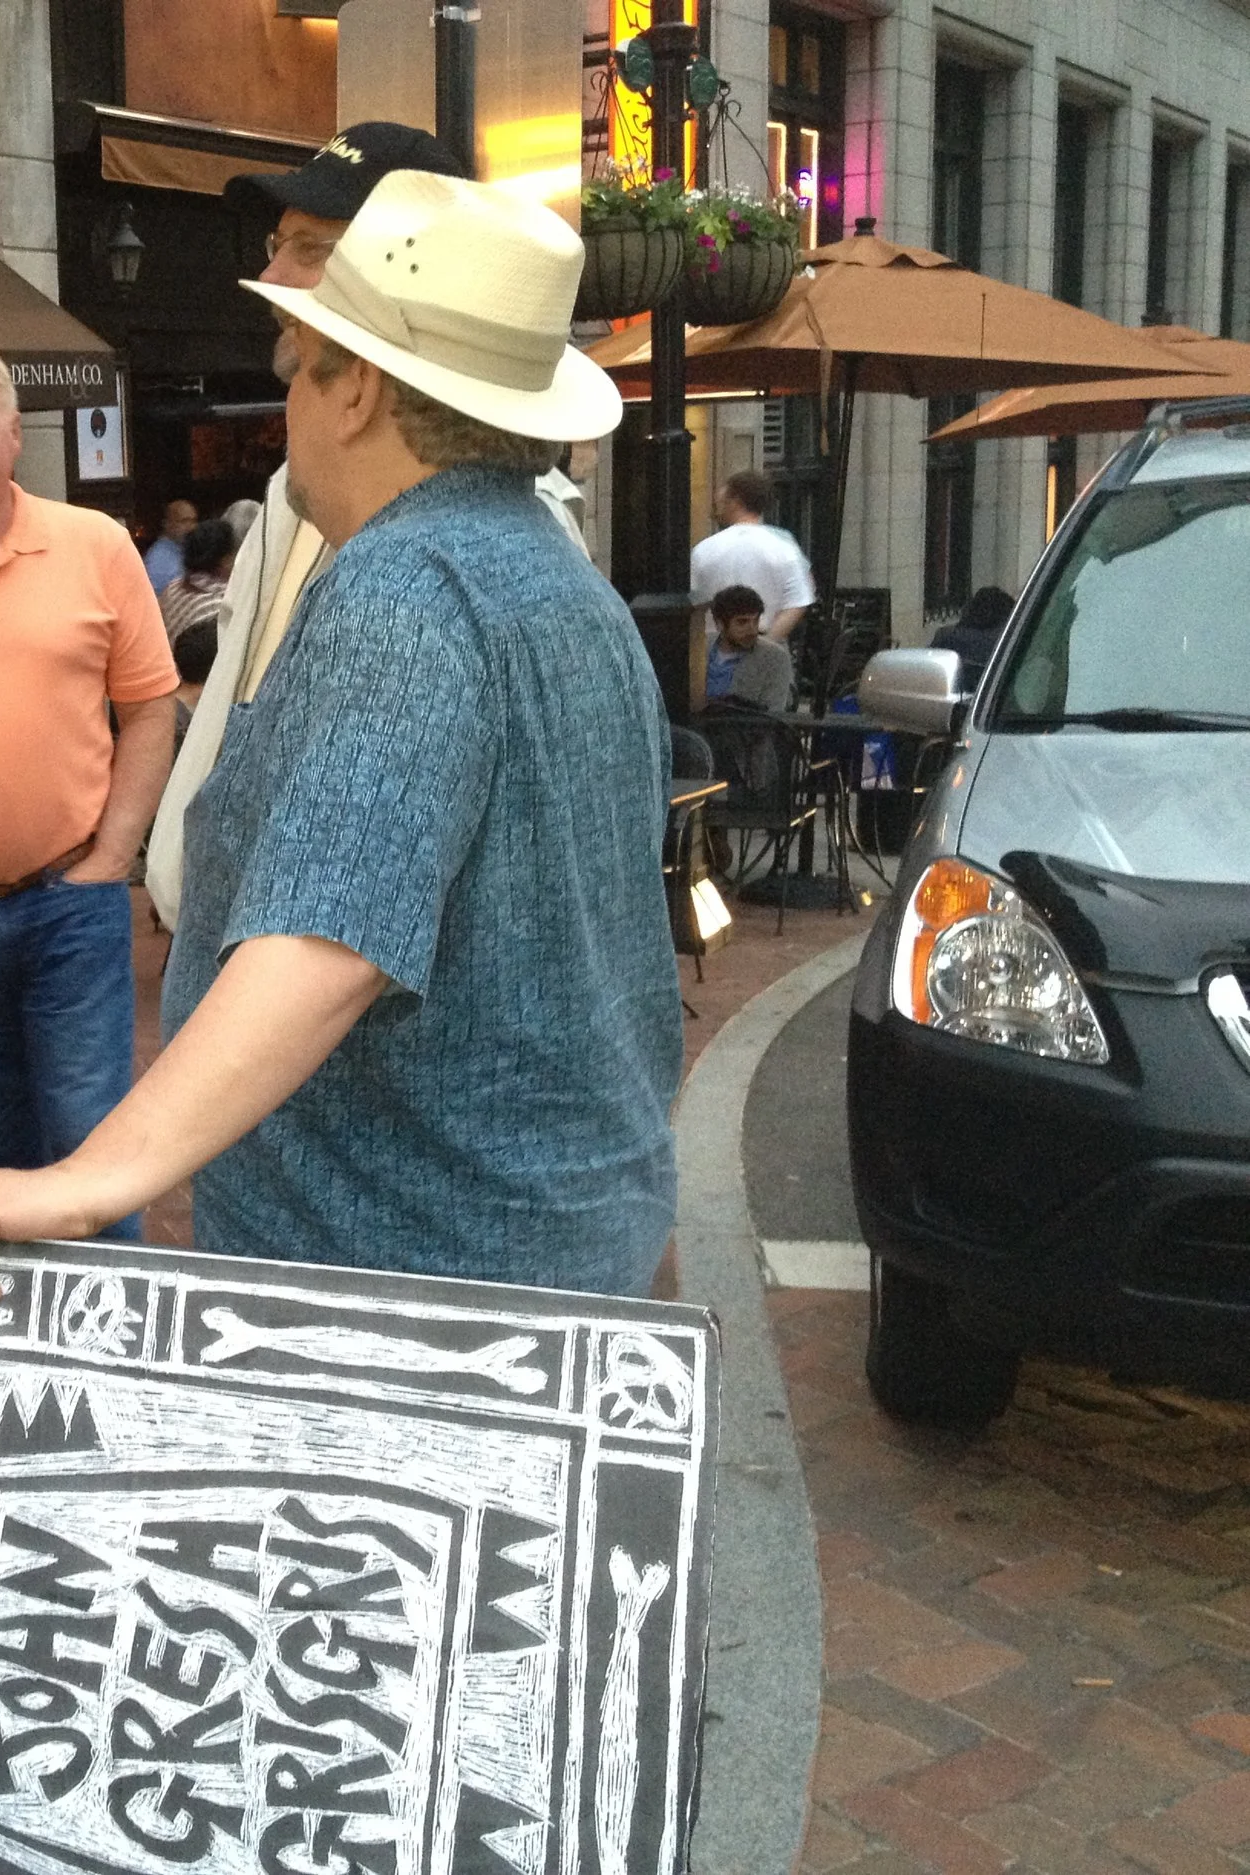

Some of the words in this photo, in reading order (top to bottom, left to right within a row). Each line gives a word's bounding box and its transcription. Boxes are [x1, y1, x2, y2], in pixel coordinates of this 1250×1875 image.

[10, 362, 78, 386] DENHAM
[82, 362, 103, 386] CO.
[108, 1520, 266, 1863] GRESH
